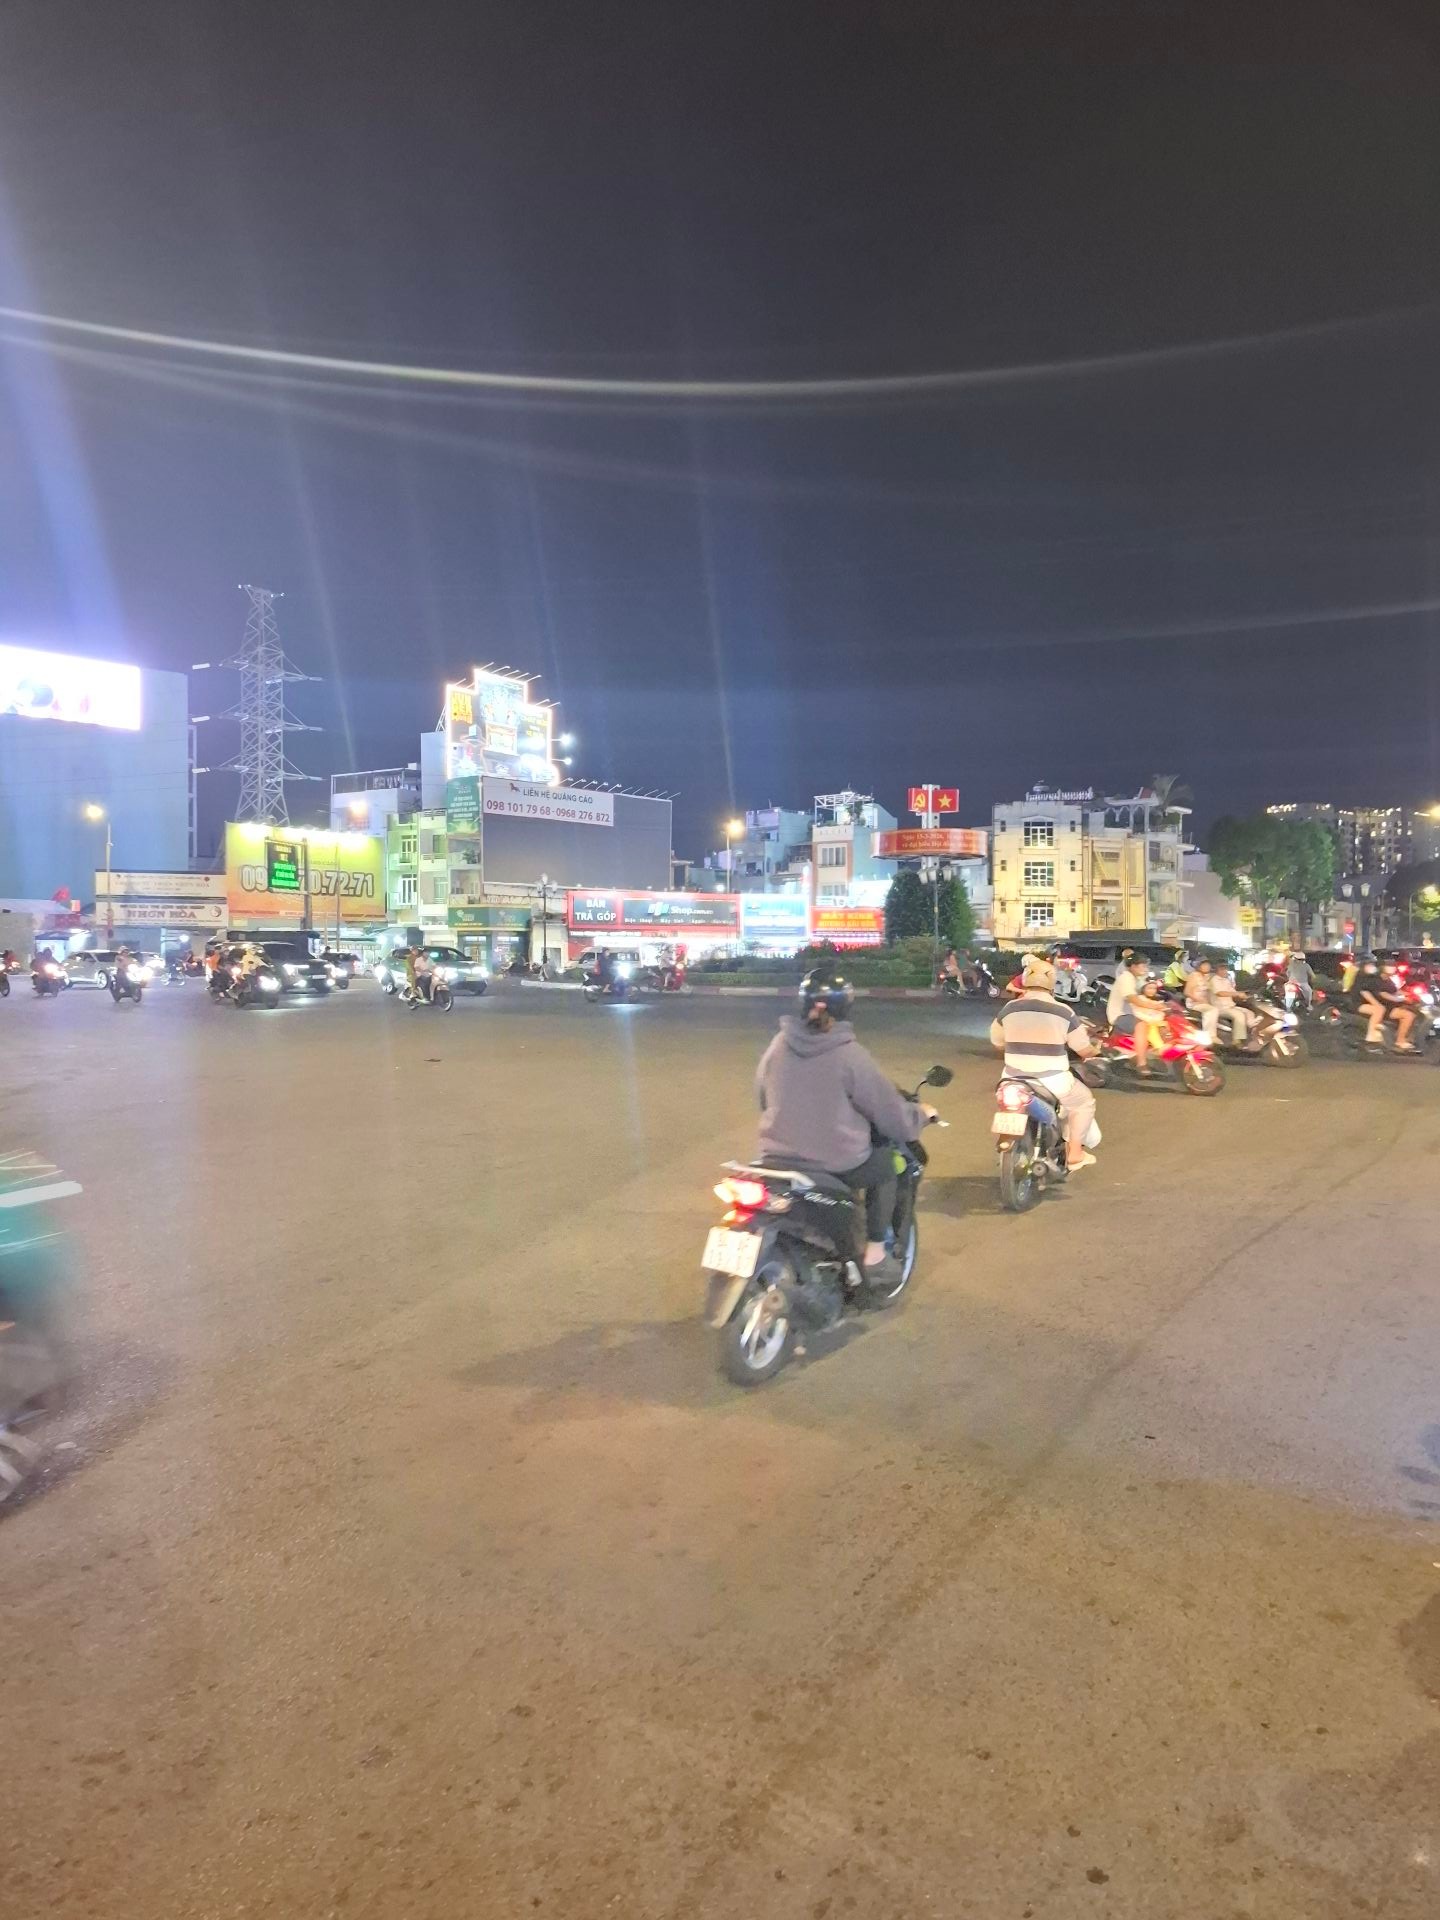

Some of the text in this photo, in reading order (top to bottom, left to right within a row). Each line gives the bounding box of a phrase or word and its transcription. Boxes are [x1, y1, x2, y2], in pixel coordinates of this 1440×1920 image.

[523, 788, 540, 798] LIÊN
[541, 790, 550, 800] HỆ
[578, 795, 593, 804] CÁO
[486, 800, 505, 811] 098
[507, 802, 524, 813] 101
[526, 804, 538, 814] 79
[540, 806, 551, 816] 68
[556, 807, 576, 818] 0968
[578, 810, 593, 821] 276
[595, 812, 610, 823] 872
[586, 898, 606, 908] BÁN
[169, 909, 197, 919] HÒA
[575, 910, 617, 922] TRẢ GÓP
